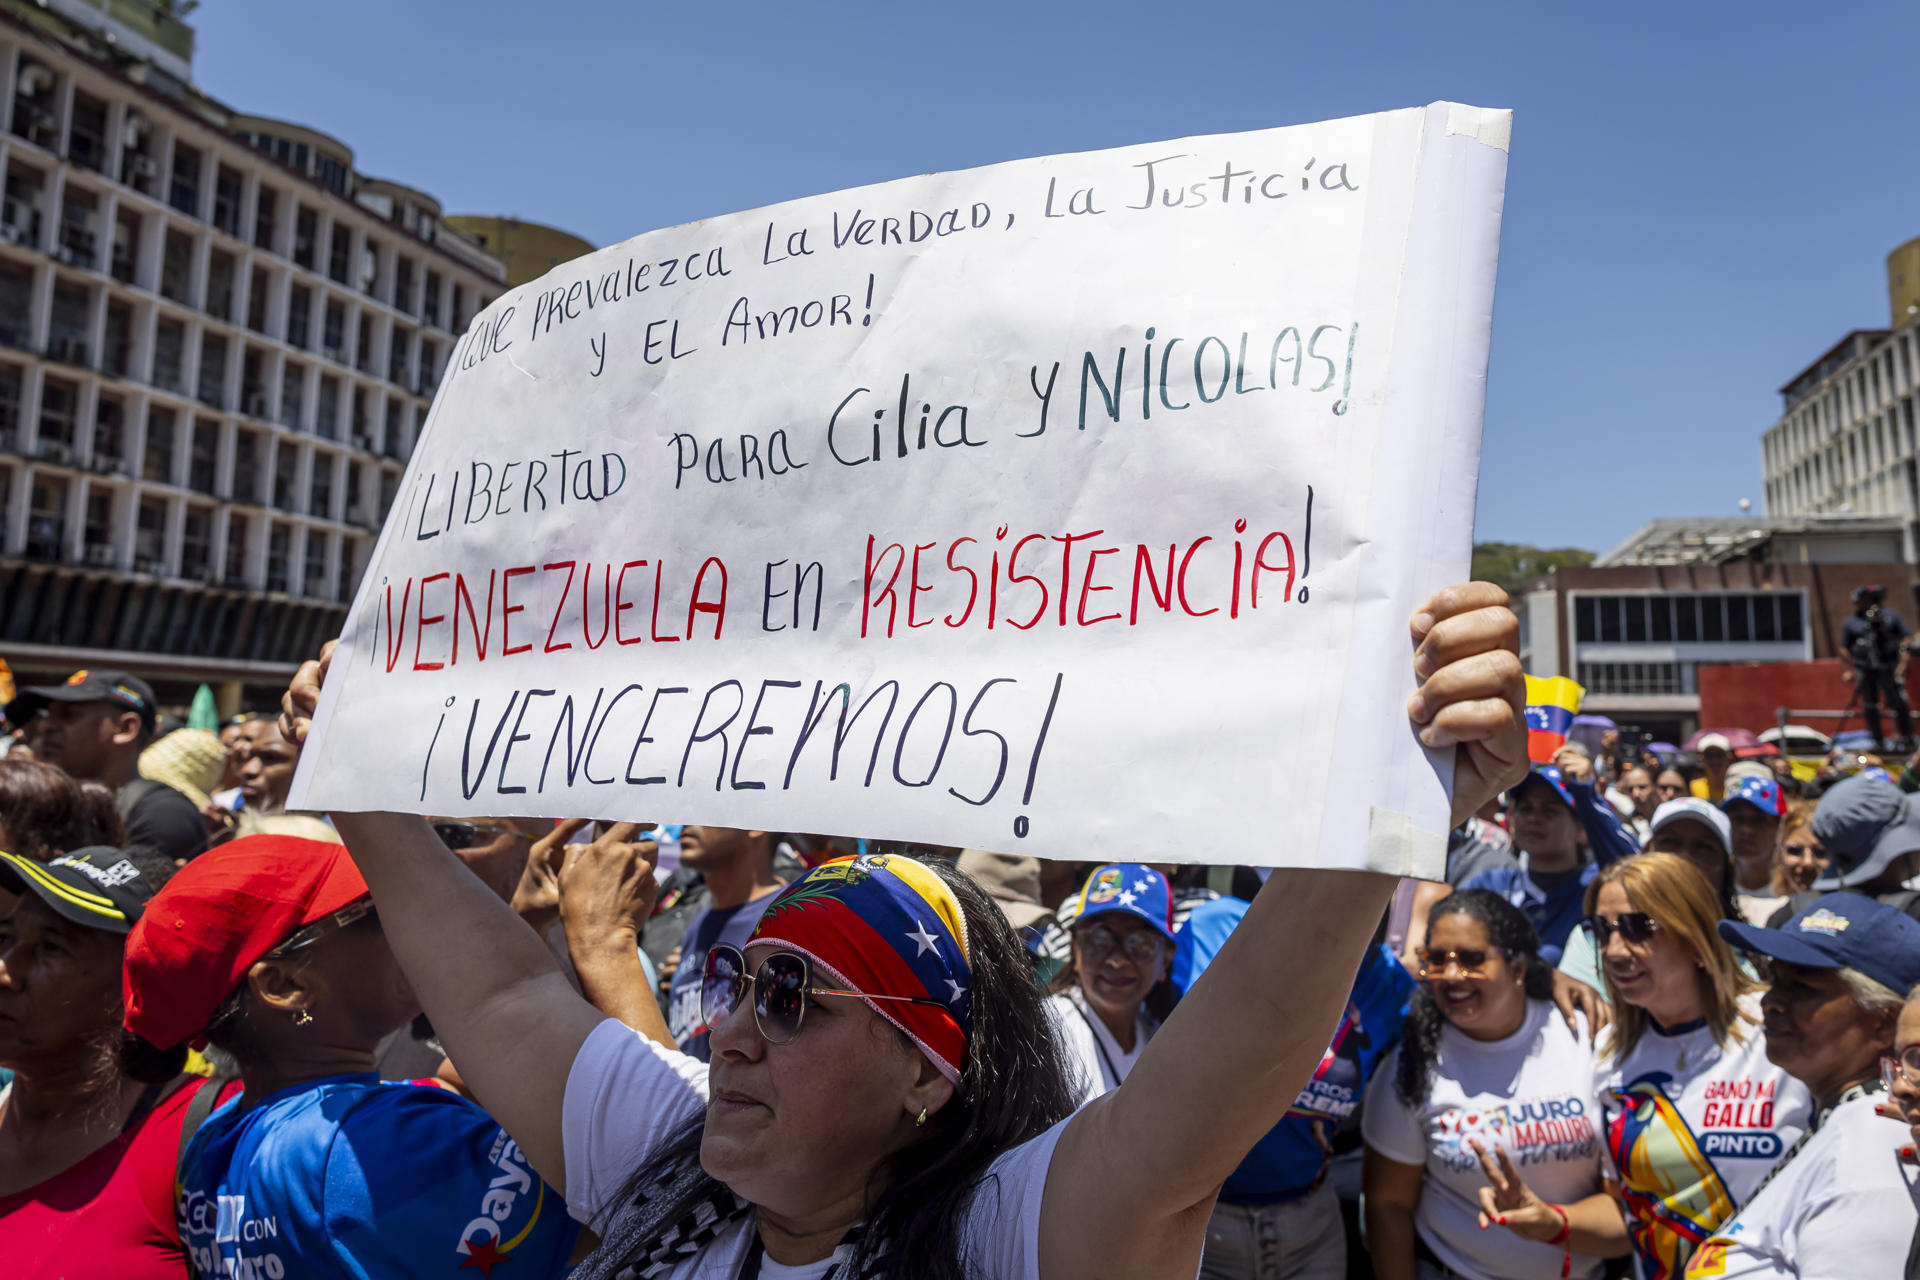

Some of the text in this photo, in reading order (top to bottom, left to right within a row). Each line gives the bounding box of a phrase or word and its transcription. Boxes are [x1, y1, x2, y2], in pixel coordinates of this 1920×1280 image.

[763, 222, 814, 265] La
[1044, 177, 1106, 218] La
[827, 373, 989, 466] Cilia
[370, 556, 728, 673] ¡VENEZUELA
[1512, 1098, 1584, 1123] JURO
[1703, 1101, 1774, 1128] GALLO
[1514, 1115, 1596, 1147] MADURO
[1705, 1134, 1776, 1154] PINTO
[243, 1215, 277, 1242] CON
